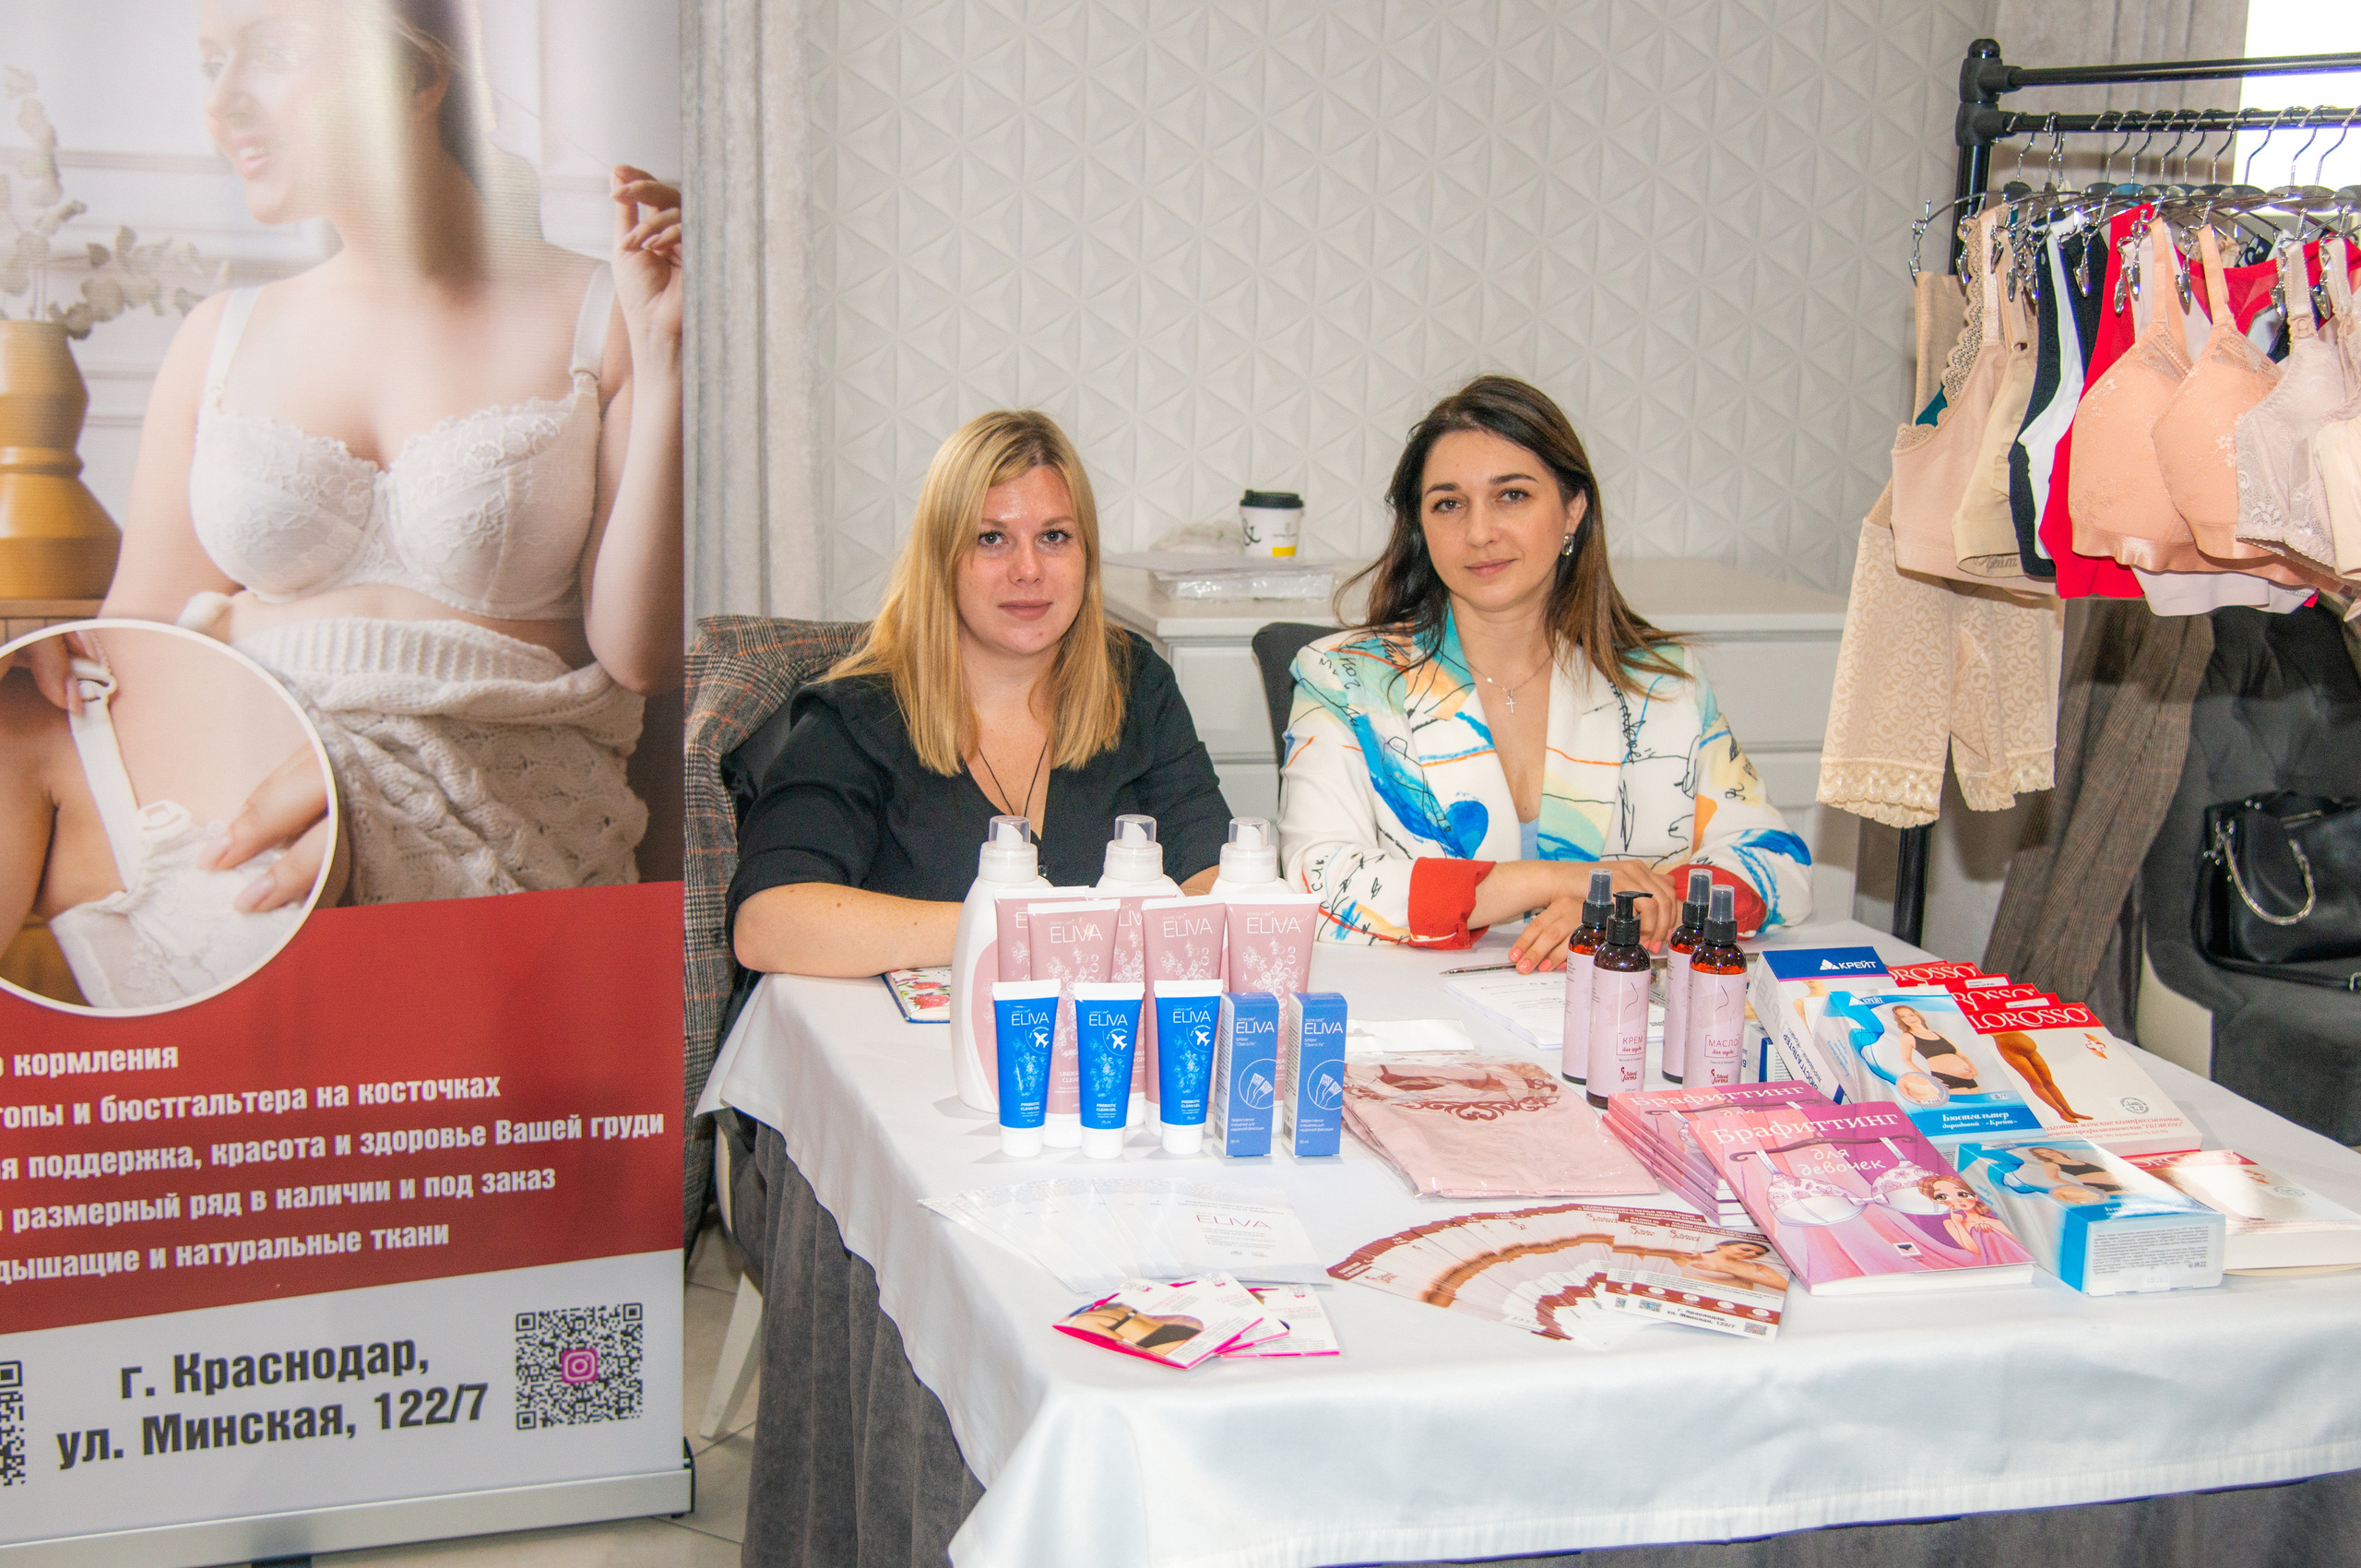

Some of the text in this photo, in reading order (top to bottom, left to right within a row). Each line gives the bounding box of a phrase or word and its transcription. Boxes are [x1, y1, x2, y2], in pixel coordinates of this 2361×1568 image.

[1163, 918, 1213, 938] ELIVA
[1247, 917, 1301, 934] ELIVA
[1050, 923, 1103, 944] ELIVA
[1838, 960, 1876, 969] КРЕЙТ
[1011, 1012, 1050, 1026] ELIVA
[1088, 1014, 1128, 1027] ELIVA
[1173, 1011, 1211, 1024] ELIVA
[1236, 1021, 1275, 1034] ELIVA
[1304, 1022, 1344, 1035] ELIVA
[1622, 1036, 1643, 1045] КРЕМ
[1708, 1039, 1738, 1048] МАСЛО
[14, 1047, 177, 1078] кормления
[0, 1077, 500, 1129] опы и бюстгальтера на косточках
[1629, 1086, 1804, 1107] Брафиттинг
[1942, 1112, 2010, 1122] Бюстгальтер
[1942, 1122, 1979, 1130] дородовой
[1986, 1119, 2017, 1127] «Крейт»
[2080, 1120, 2113, 1128] женские
[2115, 1117, 2183, 1127] компрессионные,
[1711, 1113, 1898, 1145] Брафиттинг
[28, 1146, 202, 1182] поддержка,
[212, 1136, 325, 1166] красота
[336, 1134, 350, 1155] и
[361, 1126, 485, 1154] здоровье
[496, 1114, 581, 1144] Вашей
[591, 1114, 663, 1136] груди
[1811, 1148, 1850, 1160] для
[1801, 1158, 1887, 1175] девочек
[13, 1193, 179, 1233] размерный
[191, 1193, 241, 1219] ряд
[251, 1191, 266, 1211] в
[277, 1181, 389, 1209] наличии
[400, 1179, 414, 1199] и
[425, 1175, 472, 1198] под
[482, 1169, 554, 1193] заказ
[1196, 1214, 1273, 1230] ELIVA
[150, 1248, 165, 1269] и
[176, 1231, 361, 1266] натуральные
[371, 1225, 448, 1249] ткани
[1679, 1313, 1713, 1324] Минская,
[1686, 1309, 1726, 1322] Краснодар,
[121, 1339, 428, 1399] г. Краснодар,
[57, 1384, 486, 1469] ул. Минская, 122/7
